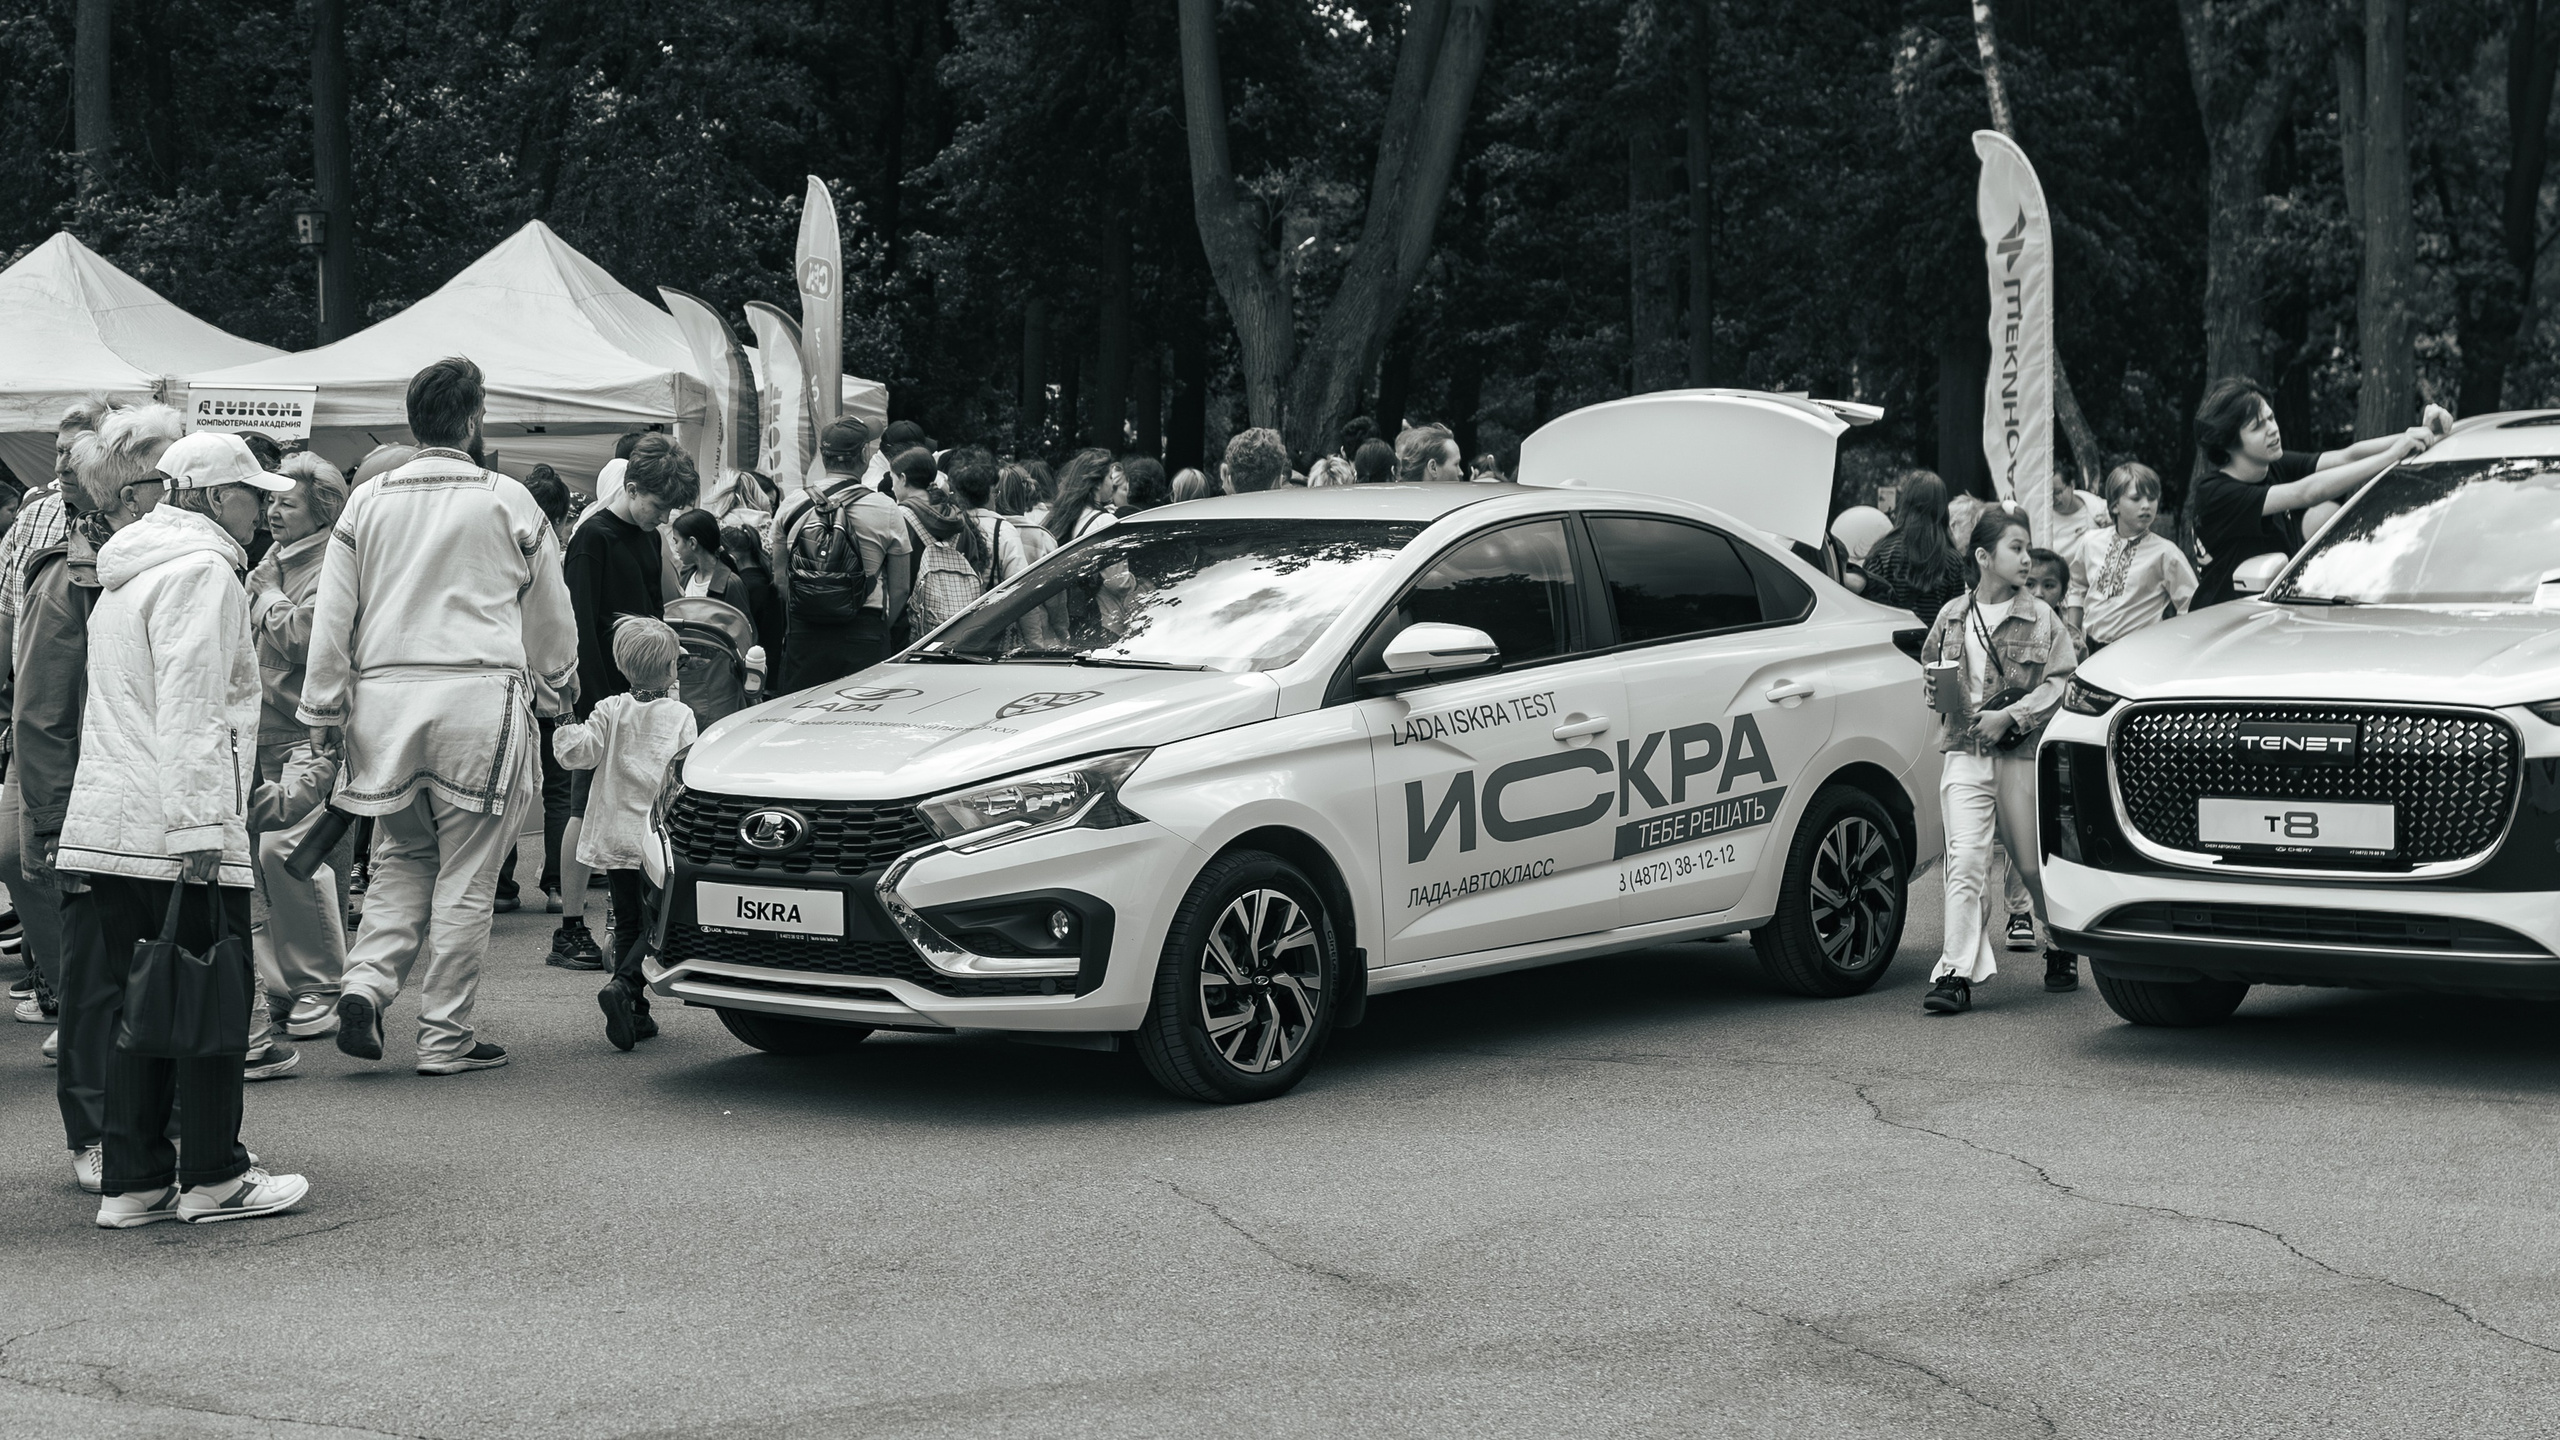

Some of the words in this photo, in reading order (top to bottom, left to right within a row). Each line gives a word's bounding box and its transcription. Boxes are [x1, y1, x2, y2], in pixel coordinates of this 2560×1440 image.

[214, 401, 302, 417] RUBICONE
[196, 418, 259, 428] КОМПЬЮТЕРНАЯ
[259, 420, 302, 429] АКАДЕМИЯ
[791, 699, 884, 713] LADA
[1391, 716, 1448, 747] LADA
[1450, 702, 1509, 734] ISKRA
[1509, 691, 1559, 722] TEST
[991, 726, 1020, 735] КХЛ
[2240, 735, 2352, 752] TENET
[1405, 713, 1777, 864] ИСКРА
[1639, 815, 1686, 849] ТЕБЕ
[1689, 797, 1767, 838] РЕШАТЬ
[2264, 811, 2319, 839] T8
[1629, 861, 1673, 892] (4872)
[1675, 843, 1736, 877] 38-12-12
[1407, 857, 1555, 908] ЛАДА-АВТОКЛАСС
[736, 896, 802, 923] ISKRA
